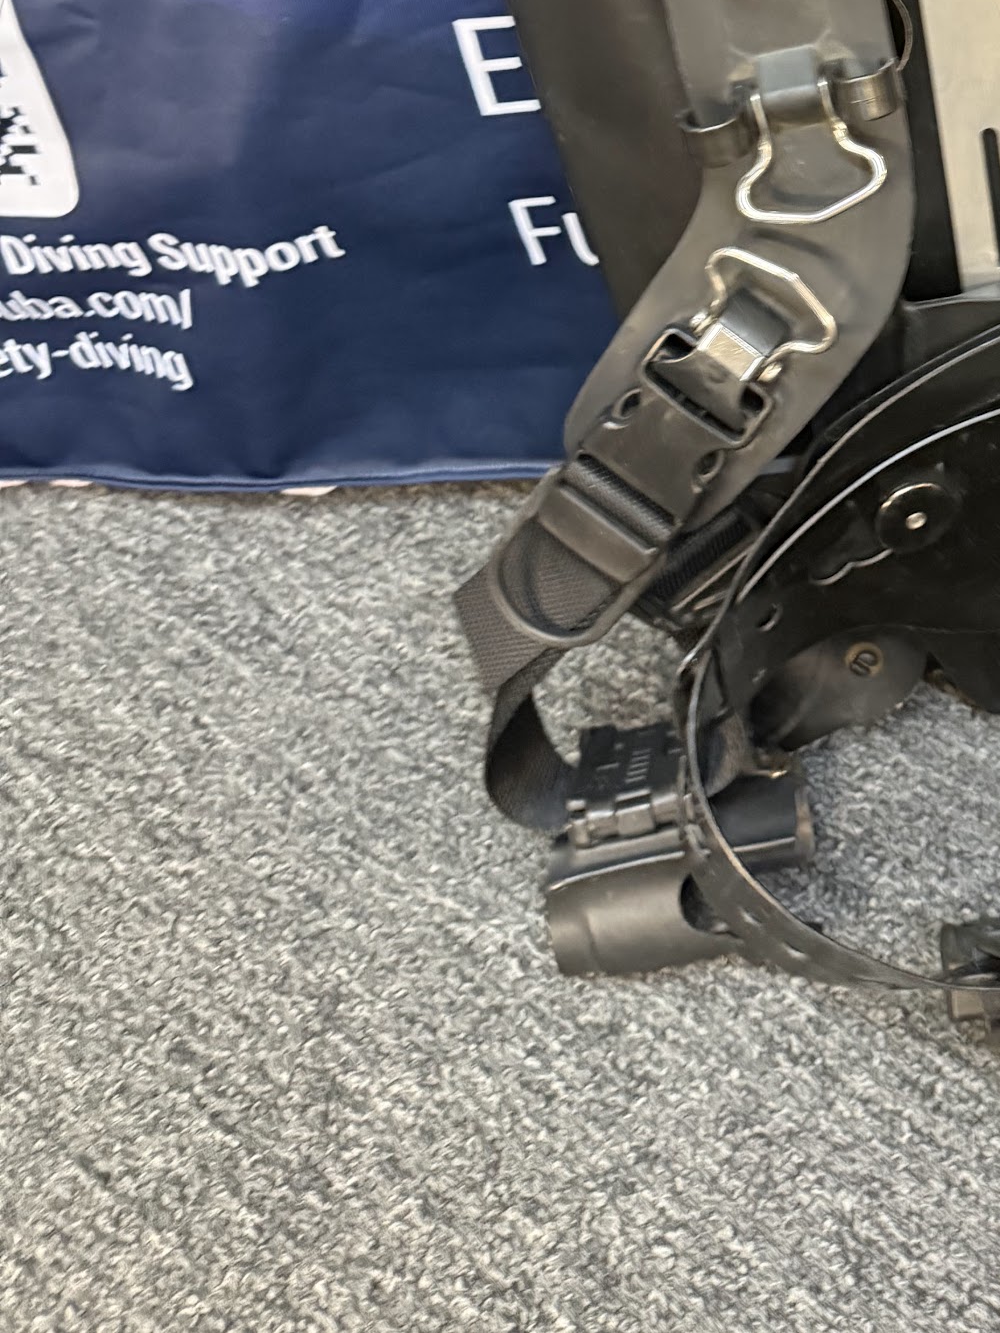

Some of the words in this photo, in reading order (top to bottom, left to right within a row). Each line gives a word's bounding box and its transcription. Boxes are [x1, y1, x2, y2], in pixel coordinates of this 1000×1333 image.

[0, 233, 152, 277] Diving
[147, 225, 346, 287] Support
[0, 288, 192, 330] uba.com/
